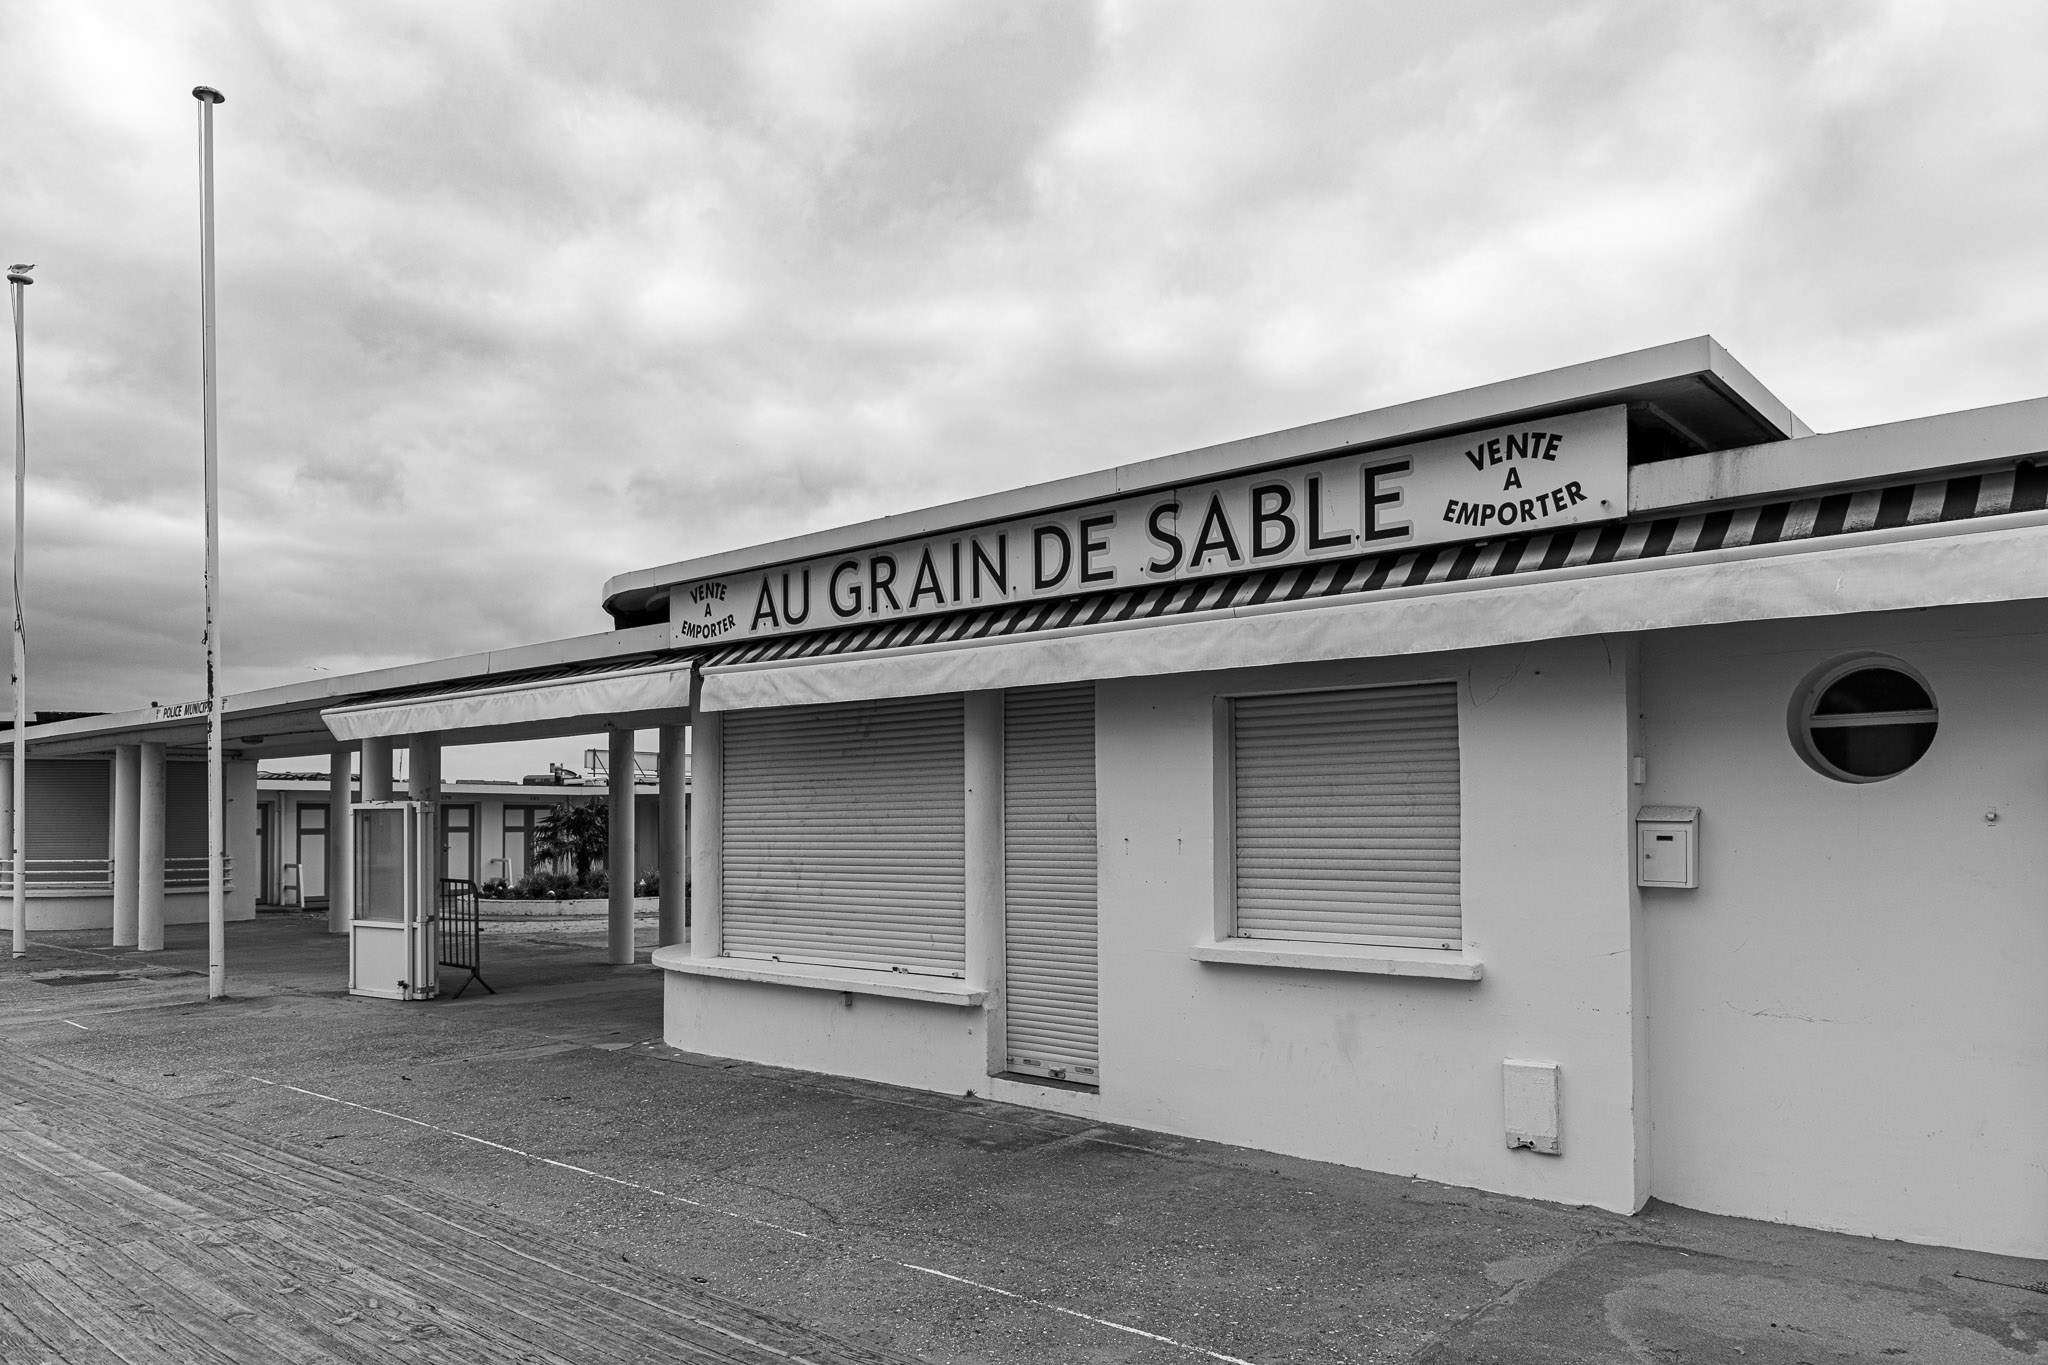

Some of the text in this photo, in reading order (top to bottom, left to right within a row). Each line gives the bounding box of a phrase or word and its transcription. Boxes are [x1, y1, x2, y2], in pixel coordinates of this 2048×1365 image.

[1464, 432, 1563, 472] VENTE
[1502, 466, 1523, 491] A
[1442, 480, 1588, 527] EMPORTER
[750, 460, 1411, 631] AU GRAIN DE SABLE
[689, 581, 728, 604] VENTE
[704, 602, 712, 617] A
[681, 613, 737, 639] EMPORTER
[163, 701, 209, 719] POLICE MUNICIP
